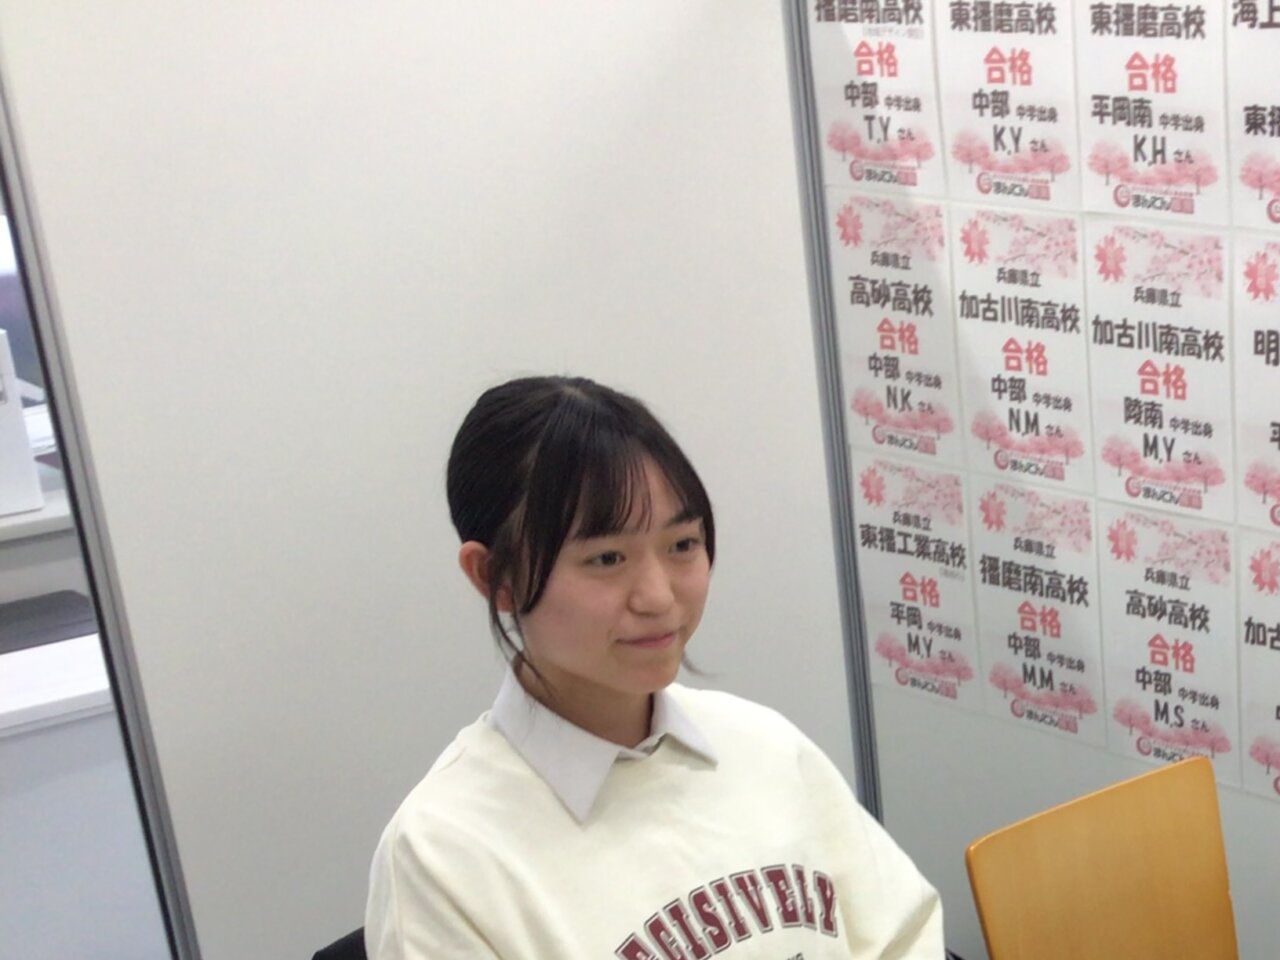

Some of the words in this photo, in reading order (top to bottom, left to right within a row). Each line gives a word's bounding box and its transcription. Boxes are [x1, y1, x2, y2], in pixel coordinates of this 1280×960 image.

[950, 1, 1057, 35] 東播磨高校
[1090, 3, 1205, 39] 東播磨高校
[854, 40, 898, 77] 合格
[984, 47, 1032, 86] 合格
[1125, 52, 1177, 93] 合格
[844, 80, 879, 109] 中部
[972, 89, 1010, 119] 中部
[1091, 94, 1153, 128] 平岡南
[848, 275, 934, 318] 高砂高校
[959, 290, 1080, 334] 加古川南高校
[877, 318, 919, 355] 合格
[1092, 314, 1225, 362] 加古川南高校
[868, 353, 900, 380] 中部
[1002, 337, 1048, 376] 合格
[991, 374, 1026, 404] 中部
[1137, 359, 1187, 401] 合格
[859, 523, 967, 570] 東播工業高校
[899, 571, 940, 608] 合格
[979, 554, 1089, 608] 播磨南高校
[889, 601, 923, 630] 平岡
[1017, 600, 1061, 639] 合格
[1125, 589, 1211, 634] 高砂高校
[1007, 632, 1041, 661] 中部
[1147, 633, 1196, 674] 合格
[1135, 666, 1172, 696] 中部
